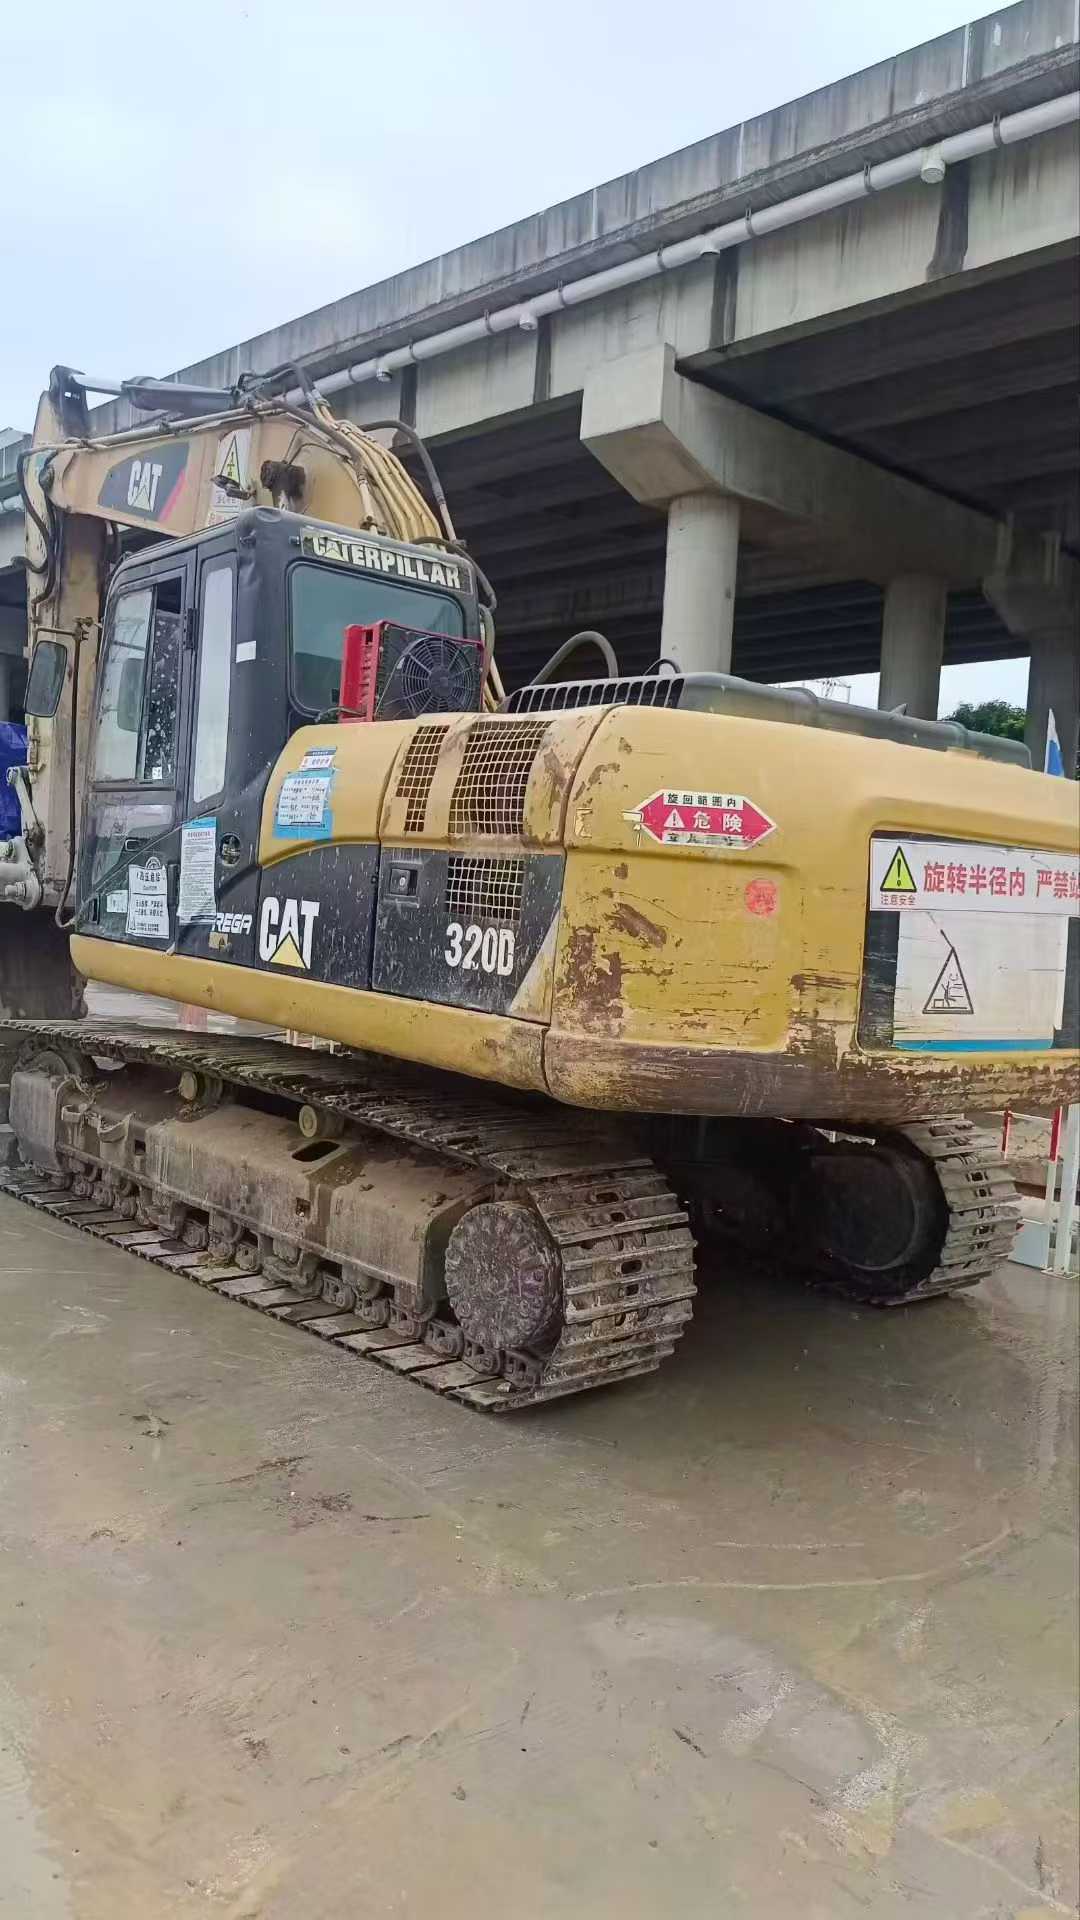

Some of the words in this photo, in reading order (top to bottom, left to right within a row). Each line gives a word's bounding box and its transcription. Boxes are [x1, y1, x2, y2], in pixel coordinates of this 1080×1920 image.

[127, 460, 163, 512] CAT
[312, 535, 461, 589] CATERPILLAR
[880, 893, 917, 906] 注意安全
[923, 861, 1026, 897] 旋转半径内
[259, 896, 320, 969] CAT
[443, 922, 516, 976] 320D
